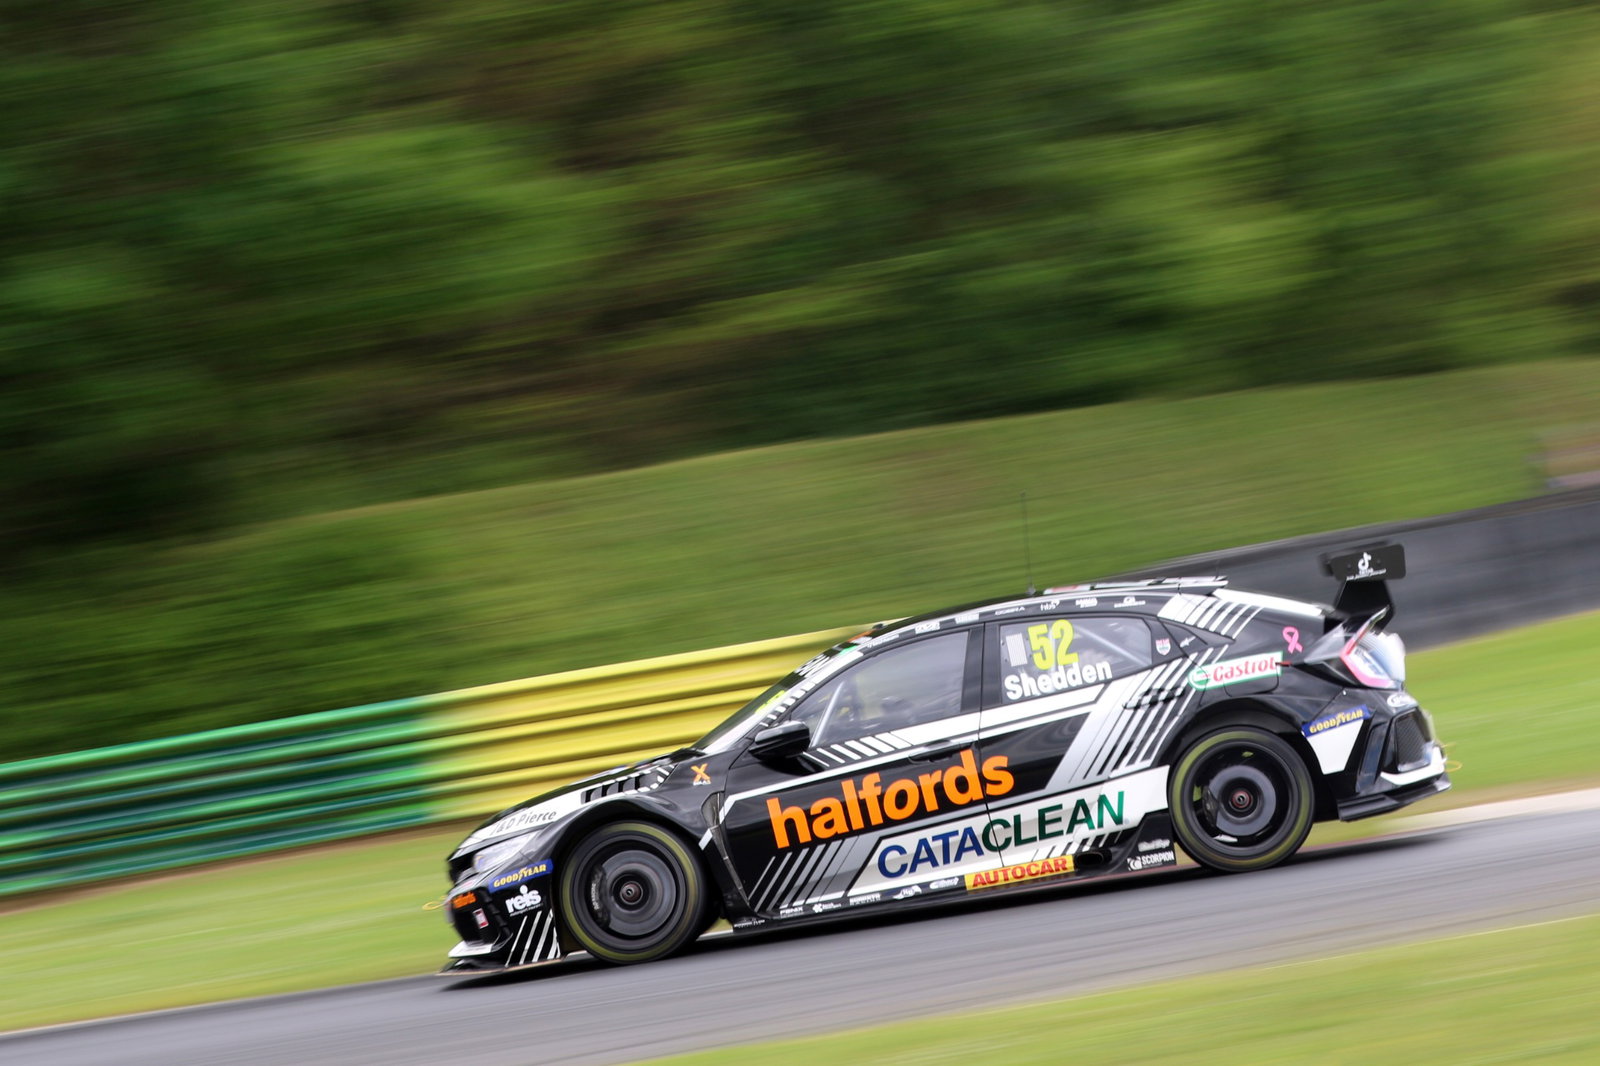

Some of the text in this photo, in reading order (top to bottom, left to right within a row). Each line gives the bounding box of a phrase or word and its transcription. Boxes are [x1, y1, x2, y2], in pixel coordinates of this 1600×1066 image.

[1027, 618, 1079, 670] 52
[1004, 660, 1113, 700] Shedden
[1212, 656, 1277, 682] Castrol
[1309, 709, 1364, 734] GOODYEAR
[766, 748, 1015, 849] halfords
[516, 810, 557, 827] Pierce
[877, 790, 1125, 879] CATACLEAN
[972, 857, 1069, 888] AUTOCAR
[1141, 850, 1175, 866] SCORPION
[493, 864, 547, 888] GOODYEAR
[505, 884, 542, 914] reis
